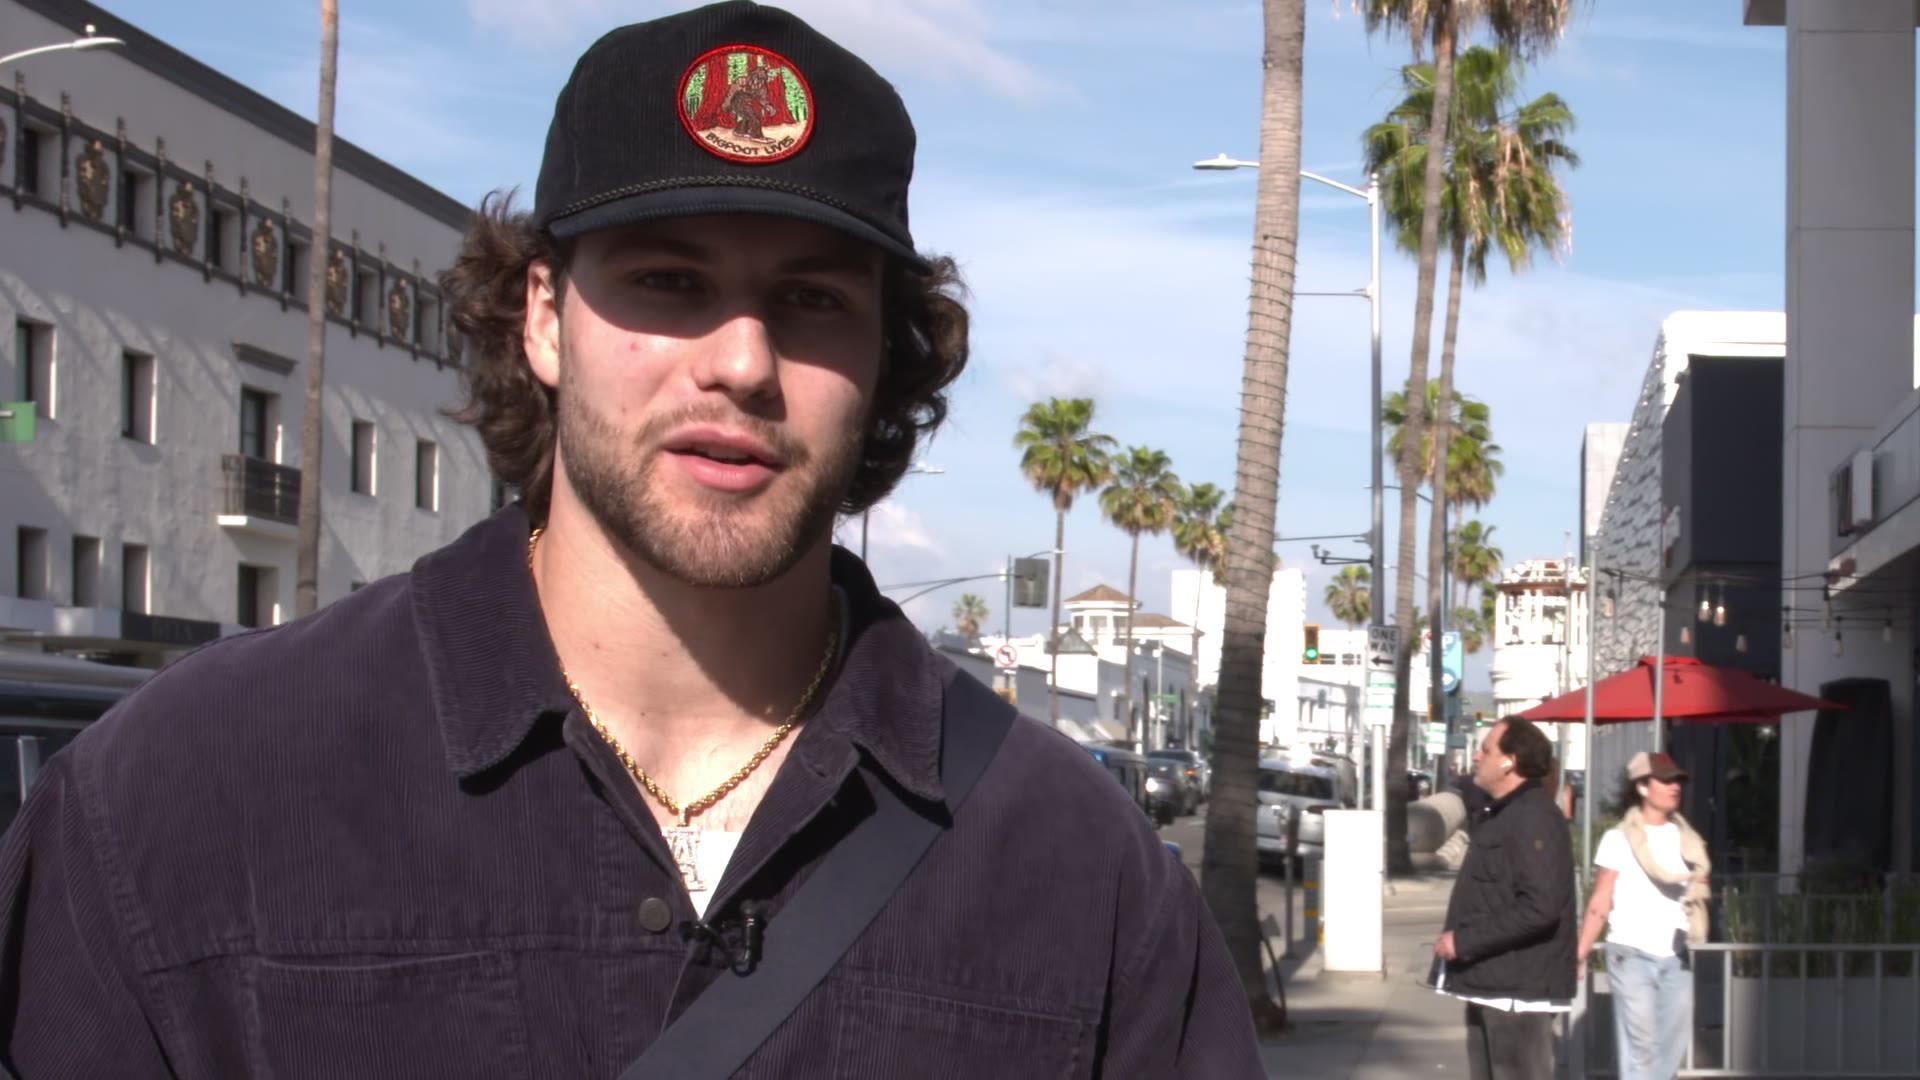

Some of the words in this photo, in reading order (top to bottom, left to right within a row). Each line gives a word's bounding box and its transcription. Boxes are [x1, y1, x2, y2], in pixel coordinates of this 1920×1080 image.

[706, 132, 760, 155] BIGFOOT
[764, 136, 795, 155] LIVES
[1371, 629, 1397, 641] ONE
[1370, 642, 1397, 654] WAY
